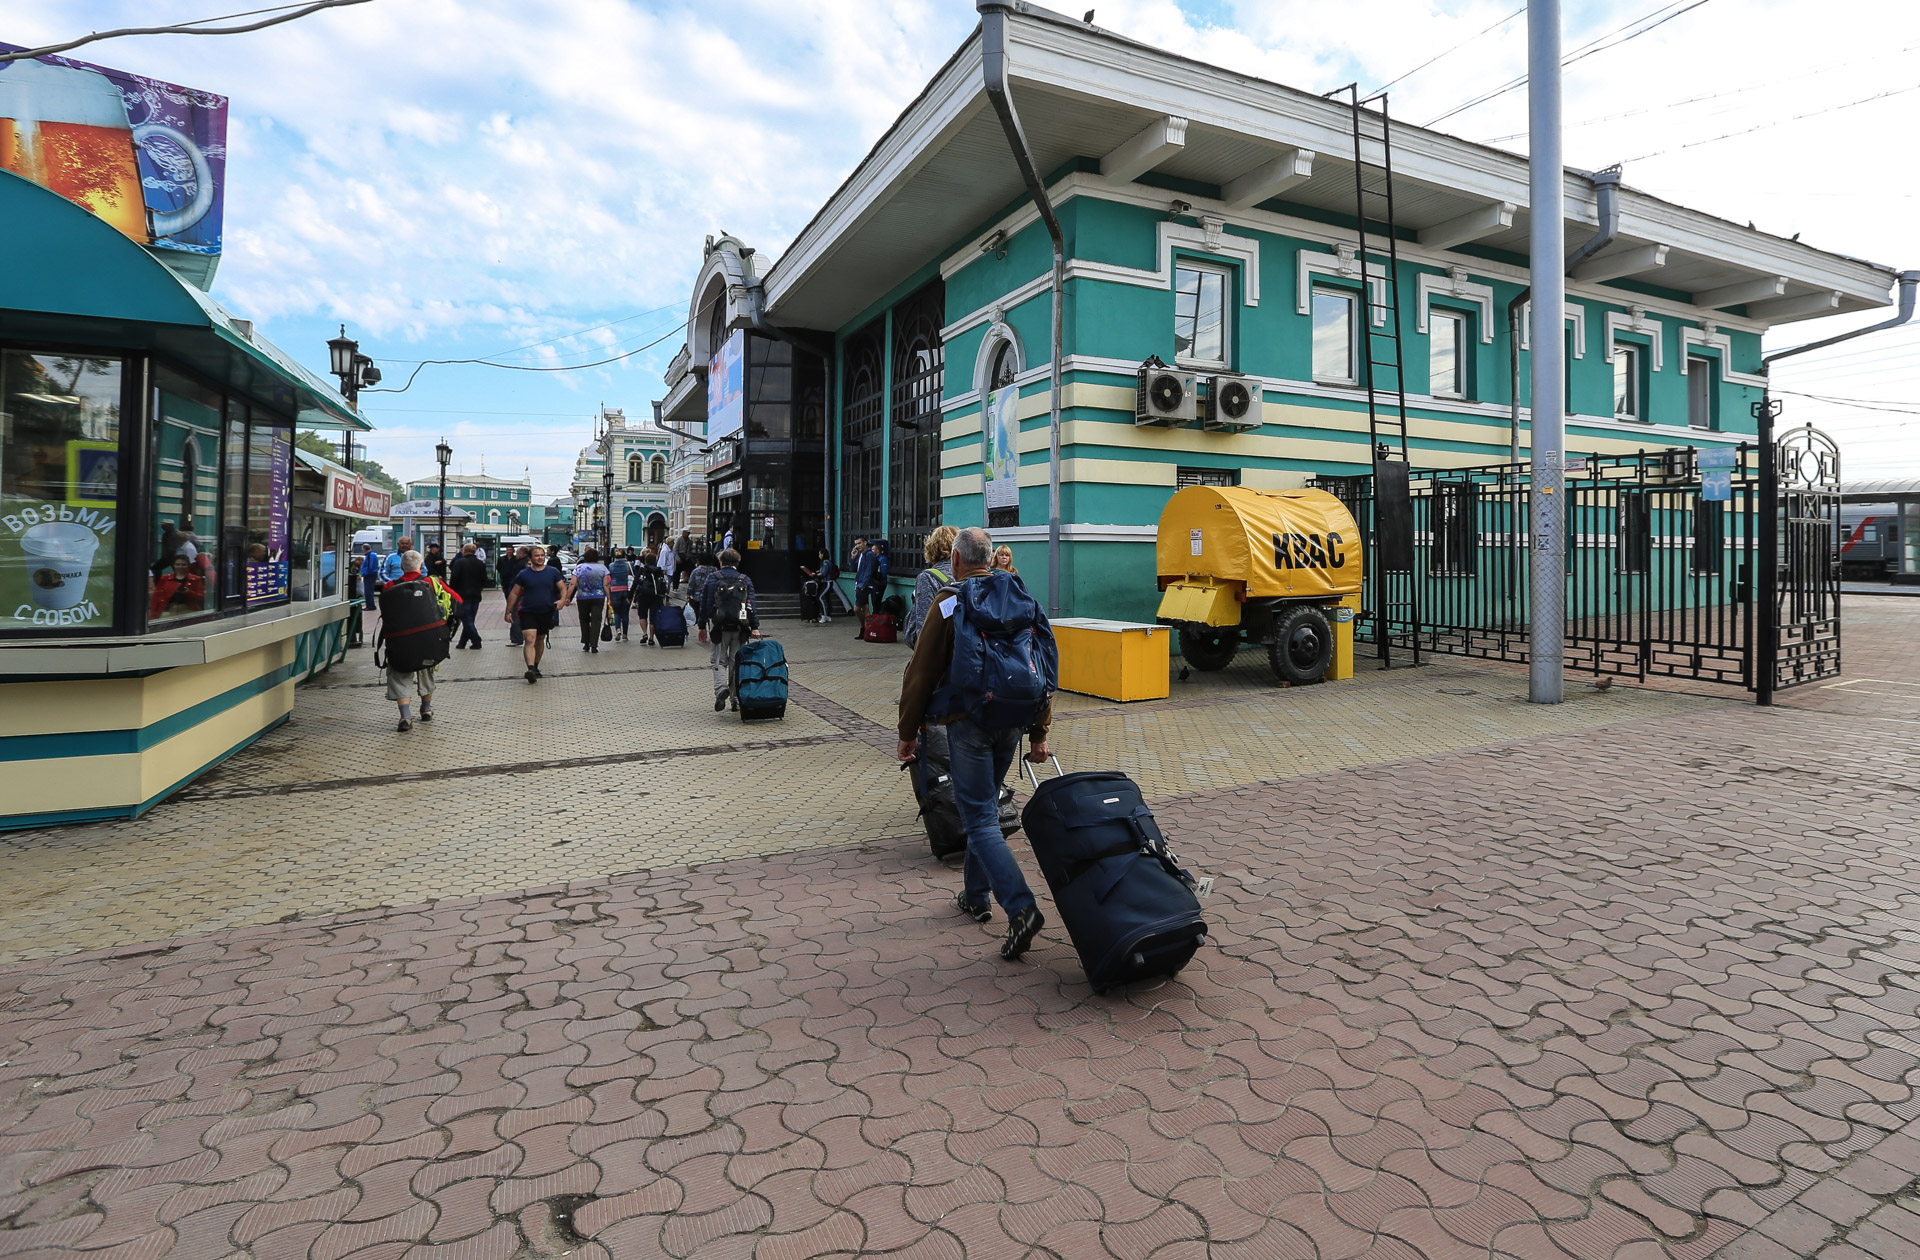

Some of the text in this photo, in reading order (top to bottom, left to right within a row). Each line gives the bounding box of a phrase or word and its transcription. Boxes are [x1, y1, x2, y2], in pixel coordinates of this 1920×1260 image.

[1, 504, 116, 535] ВОЗЬМИ
[1272, 532, 1345, 569] КВАС
[14, 599, 100, 626] С СОБОЙ
